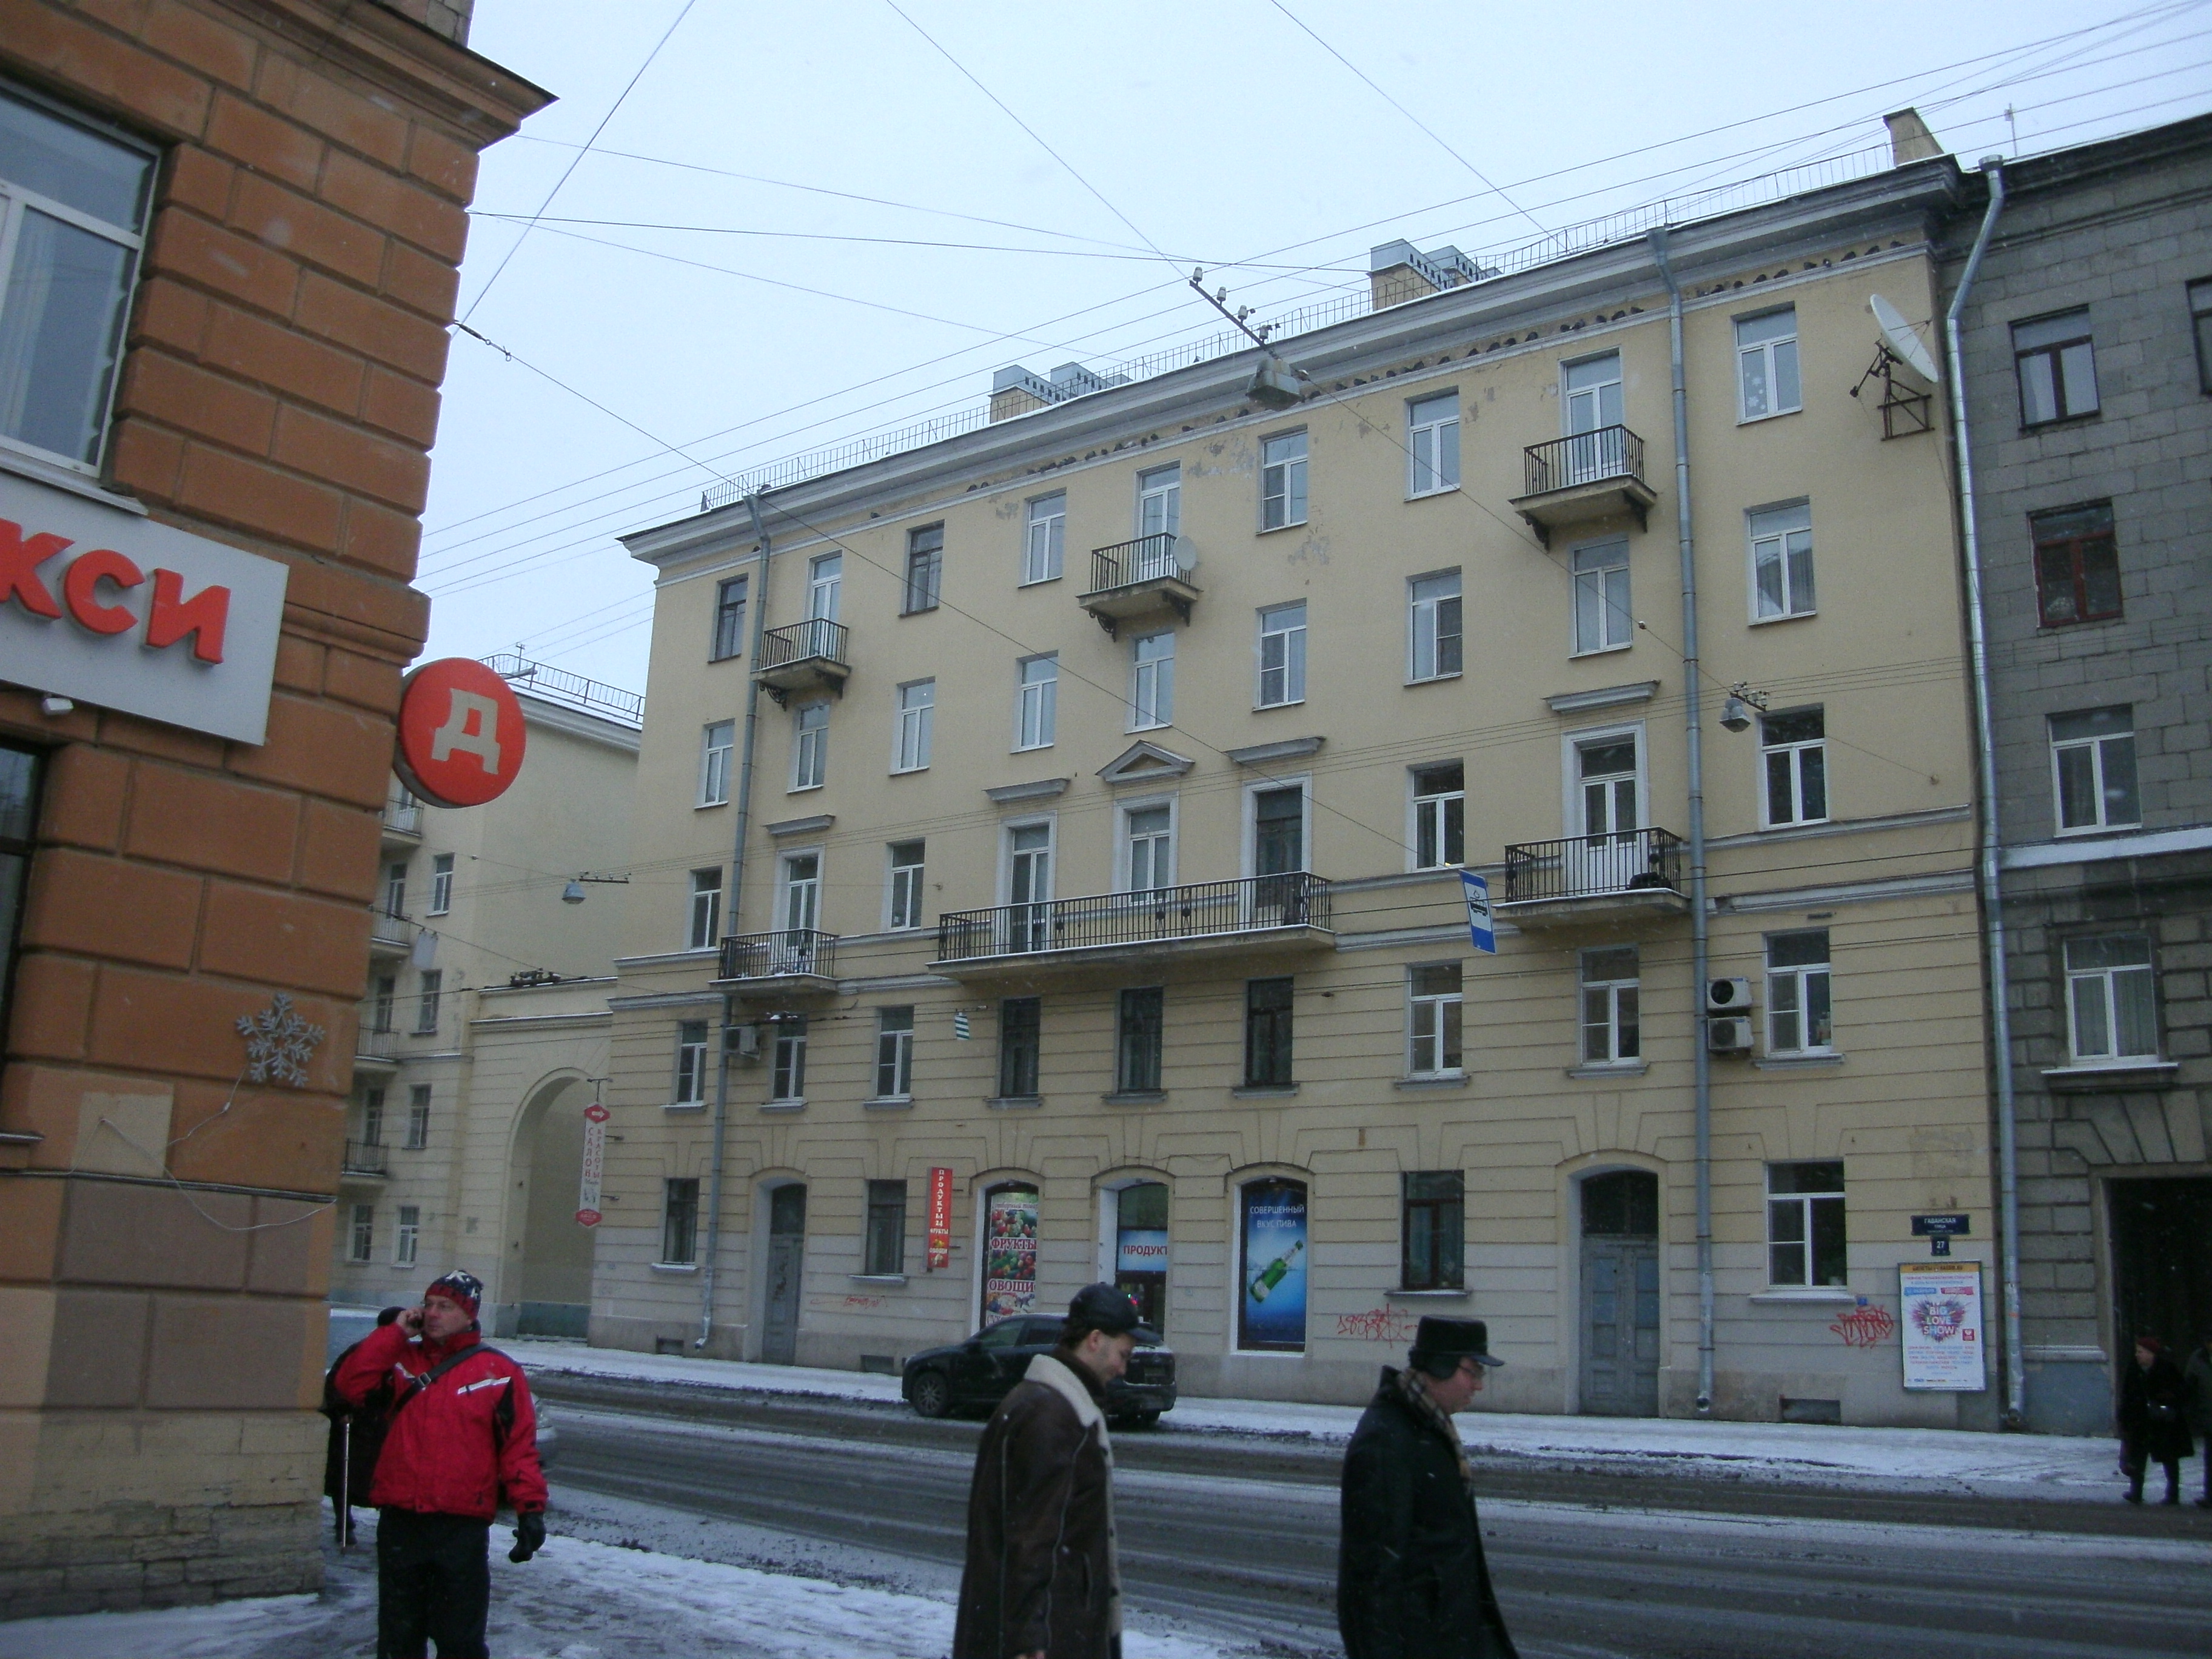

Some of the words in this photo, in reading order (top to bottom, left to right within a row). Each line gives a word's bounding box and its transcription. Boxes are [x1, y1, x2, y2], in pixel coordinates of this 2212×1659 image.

[431, 687, 501, 776] Д
[585, 1127, 594, 1177] САЛОН
[936, 1170, 945, 1219] ПРОДУКТЫ
[1250, 1204, 1304, 1213] СОВЕРШЕННЫЙ
[991, 1238, 1037, 1250] ФРУКТЫ
[989, 1279, 1034, 1293] ОВОЩИ
[1929, 1307, 1948, 1315] BIG
[1926, 1316, 1952, 1325] LOVE
[1923, 1326, 1954, 1334] SHOW
